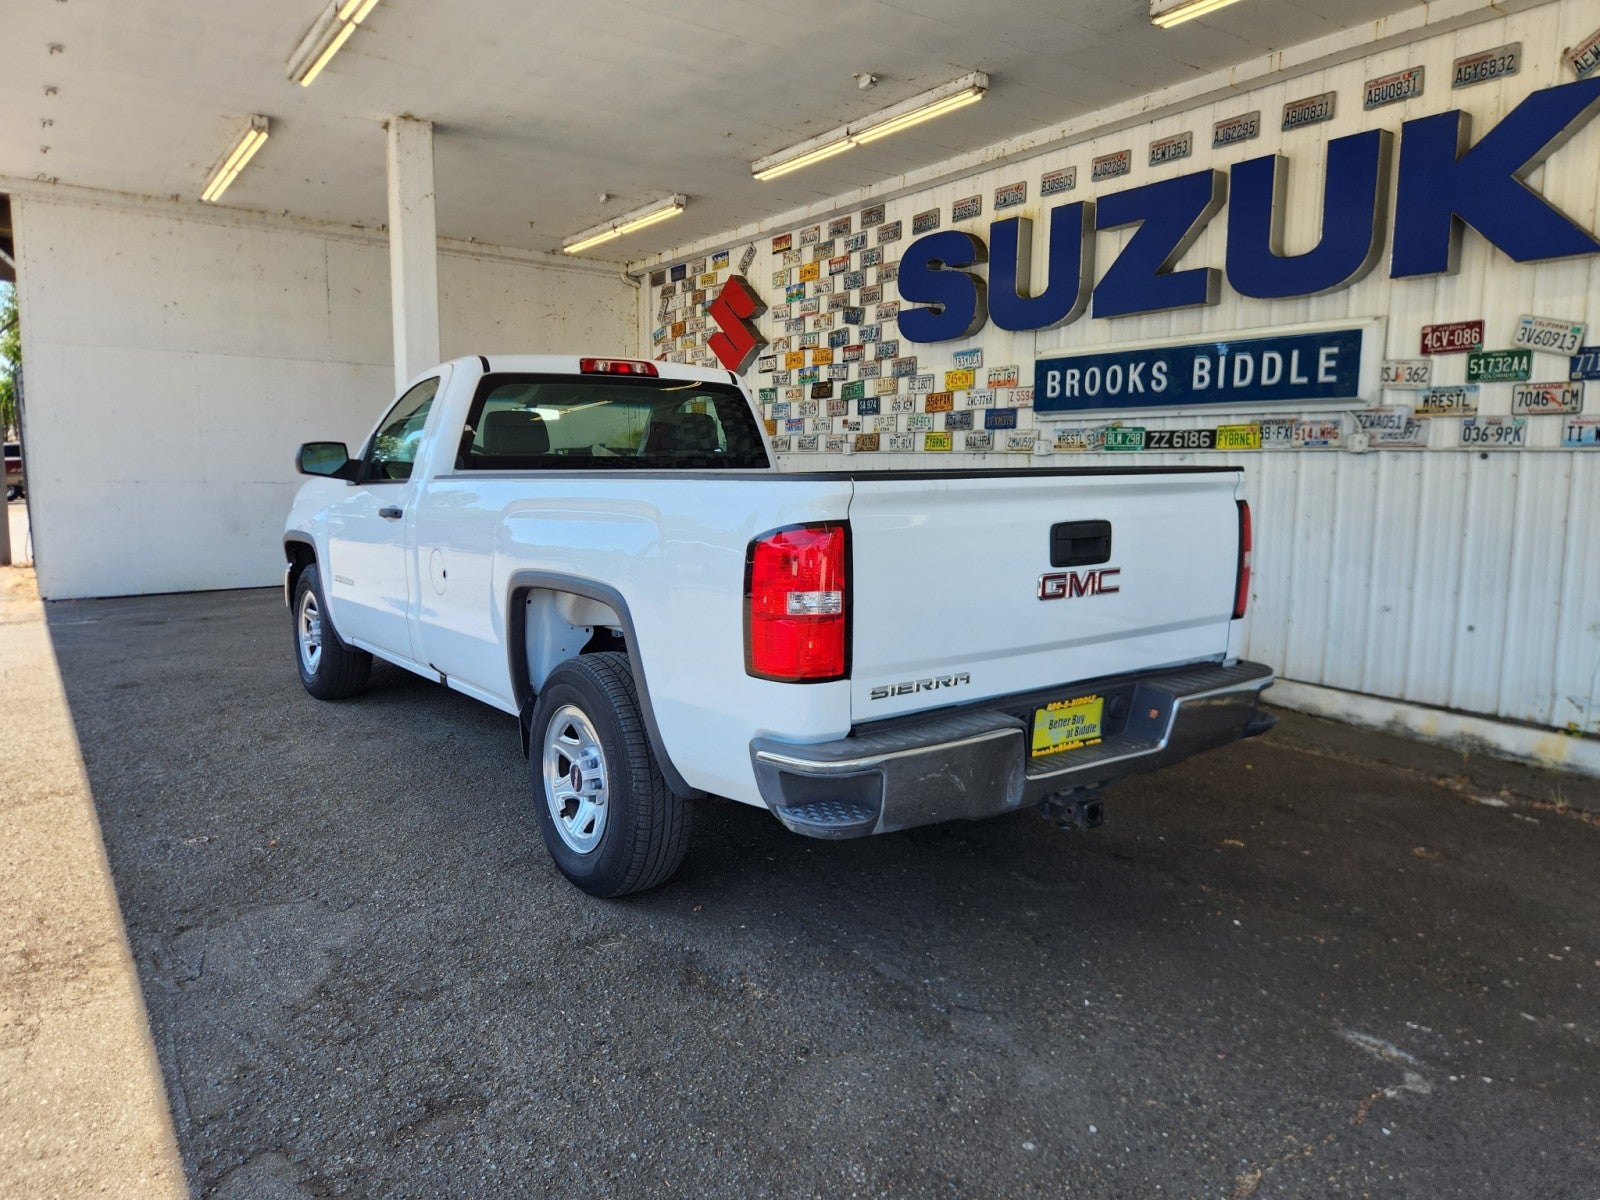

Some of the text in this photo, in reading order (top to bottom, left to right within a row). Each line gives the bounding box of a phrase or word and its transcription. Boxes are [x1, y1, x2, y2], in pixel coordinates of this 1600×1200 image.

[1455, 54, 1515, 83] AGY6832
[1366, 77, 1417, 105] ABU0831
[1284, 102, 1329, 126] ABU0831
[898, 76, 1600, 343] SUZUK
[1424, 328, 1480, 348] 4CV-086
[1517, 326, 1578, 353] 3V60913
[1046, 346, 1339, 398] BROOKS BIDDLE
[1406, 366, 1428, 382] 362
[1470, 356, 1528, 374] 51732AA
[1422, 393, 1470, 409] WRESTL
[1518, 389, 1579, 408] 7046 CM
[1150, 431, 1211, 448] ZZ 6186
[1218, 432, 1258, 446] FYBRNET
[1037, 567, 1121, 601] GMC
[869, 672, 970, 700] SIERRA
[1048, 714, 1086, 730] Better Buy
[1066, 723, 1097, 738] at Biddle
